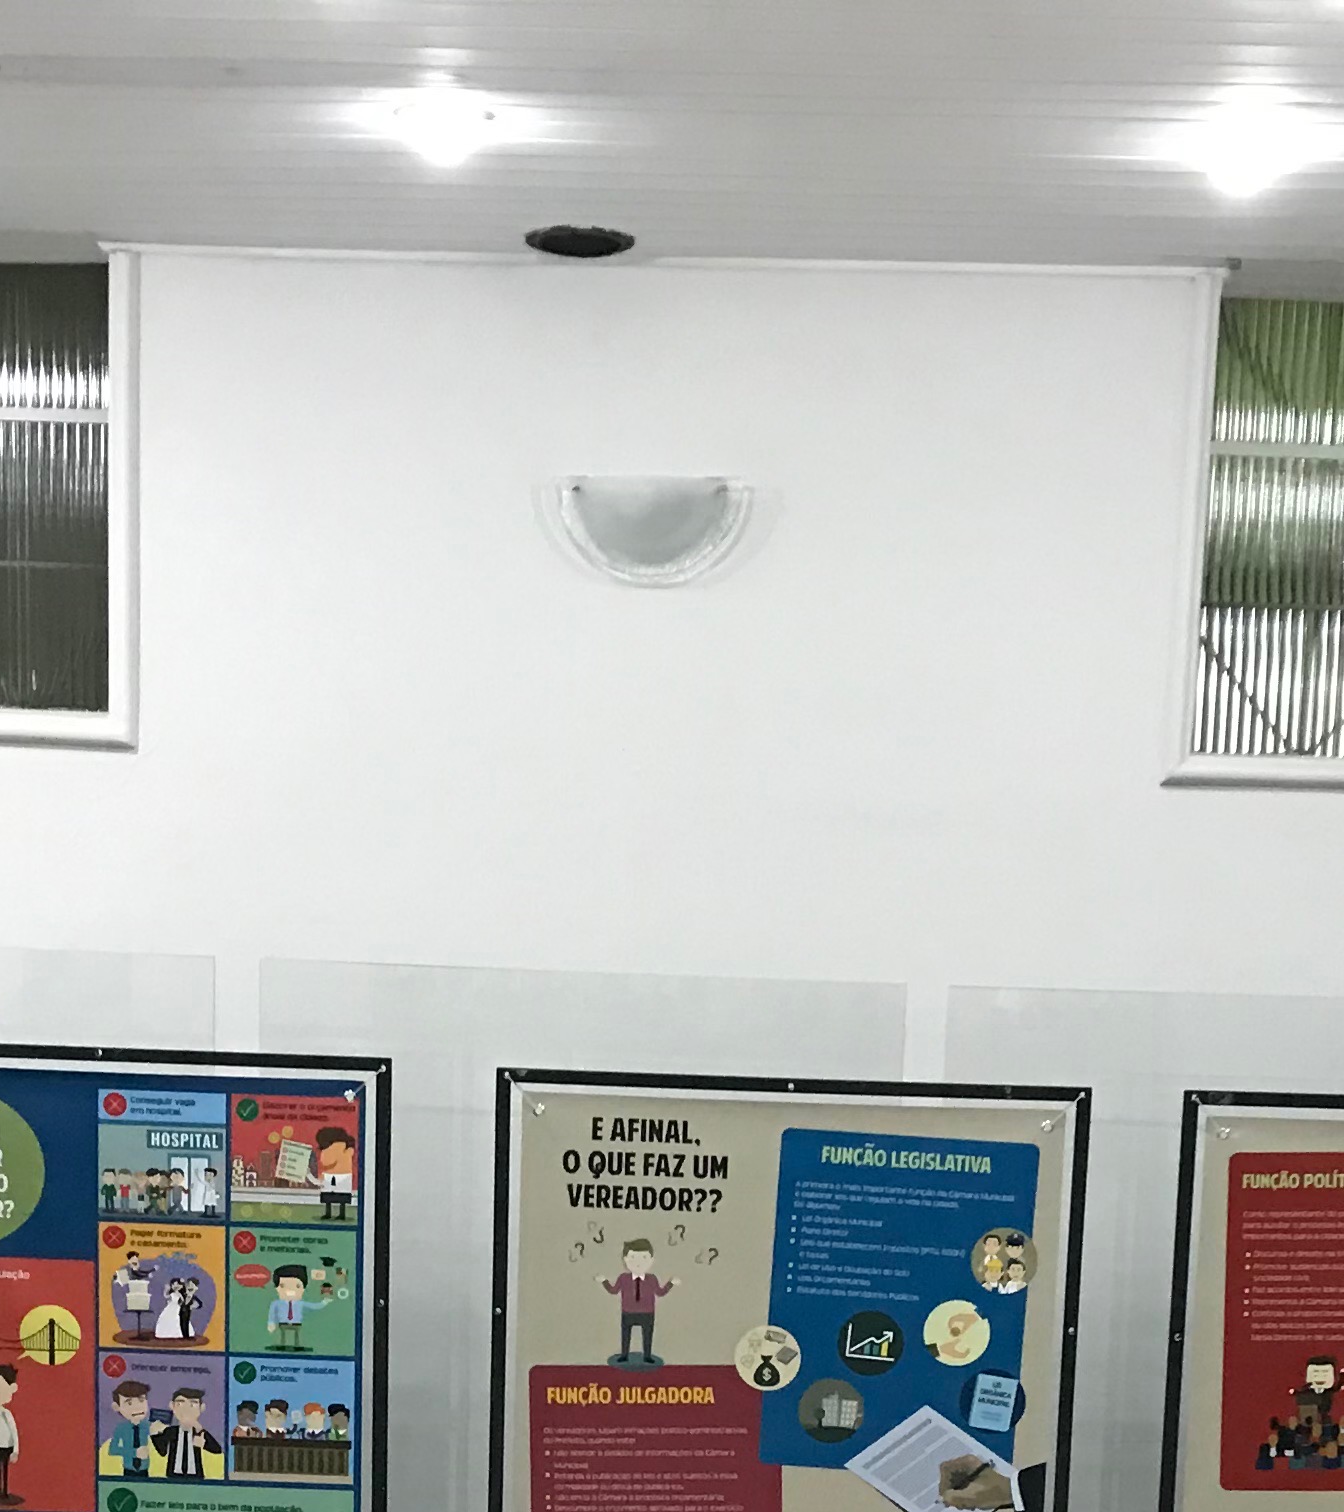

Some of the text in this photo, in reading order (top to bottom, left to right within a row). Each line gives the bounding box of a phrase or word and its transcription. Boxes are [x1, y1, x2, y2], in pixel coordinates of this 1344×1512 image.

[150, 1131, 219, 1150] HOSPITAL
[591, 1116, 701, 1146] E AFINAL,
[562, 1149, 729, 1179] O QUE FAZ UM
[820, 1142, 992, 1174] FUNÇÃO LEGISLATIVA
[1241, 1170, 1300, 1191] FUNÇÃO
[567, 1183, 723, 1213] VEREADOR??
[546, 1382, 716, 1407] FUNÇÃO JULGADORA
